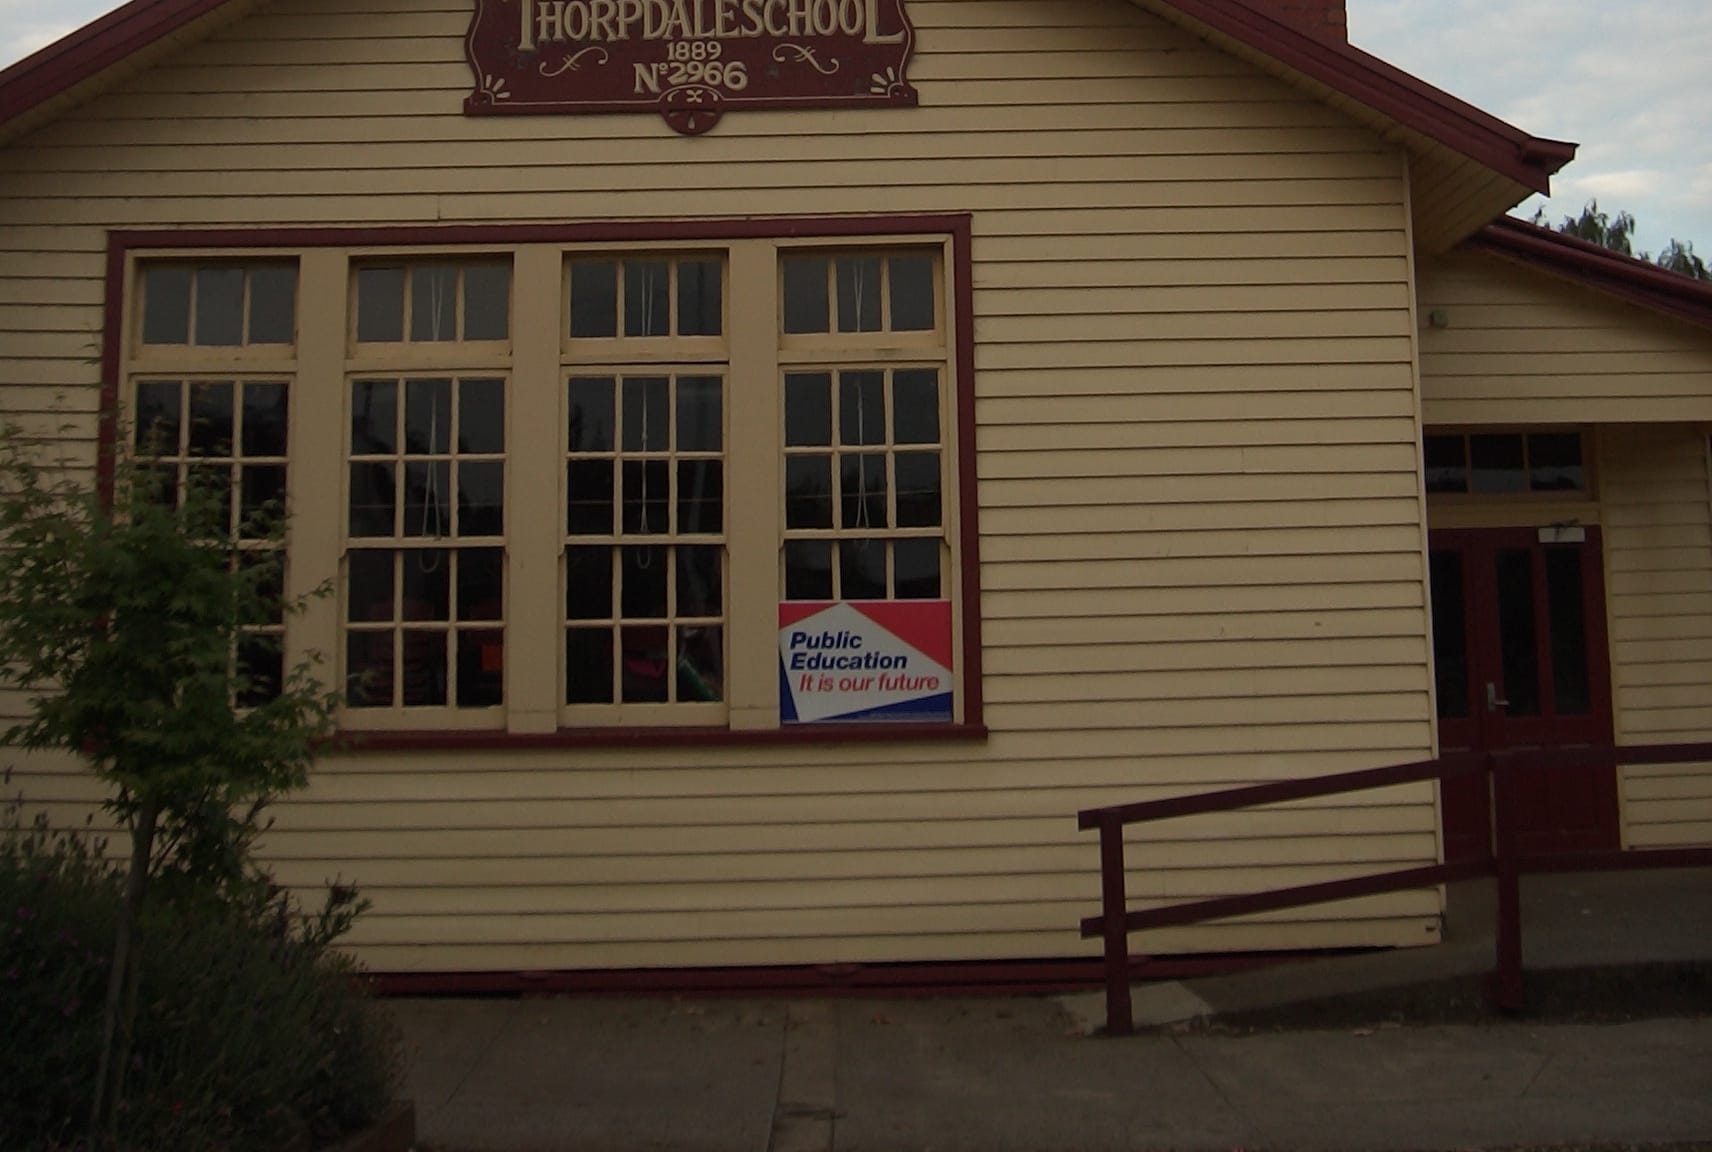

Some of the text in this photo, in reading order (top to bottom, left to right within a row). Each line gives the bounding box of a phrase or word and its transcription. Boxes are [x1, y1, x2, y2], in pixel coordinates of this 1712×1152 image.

[666, 41, 722, 61] 1889
[790, 630, 863, 649] Public
[790, 652, 908, 670] Education
[799, 672, 940, 692] It is our future
